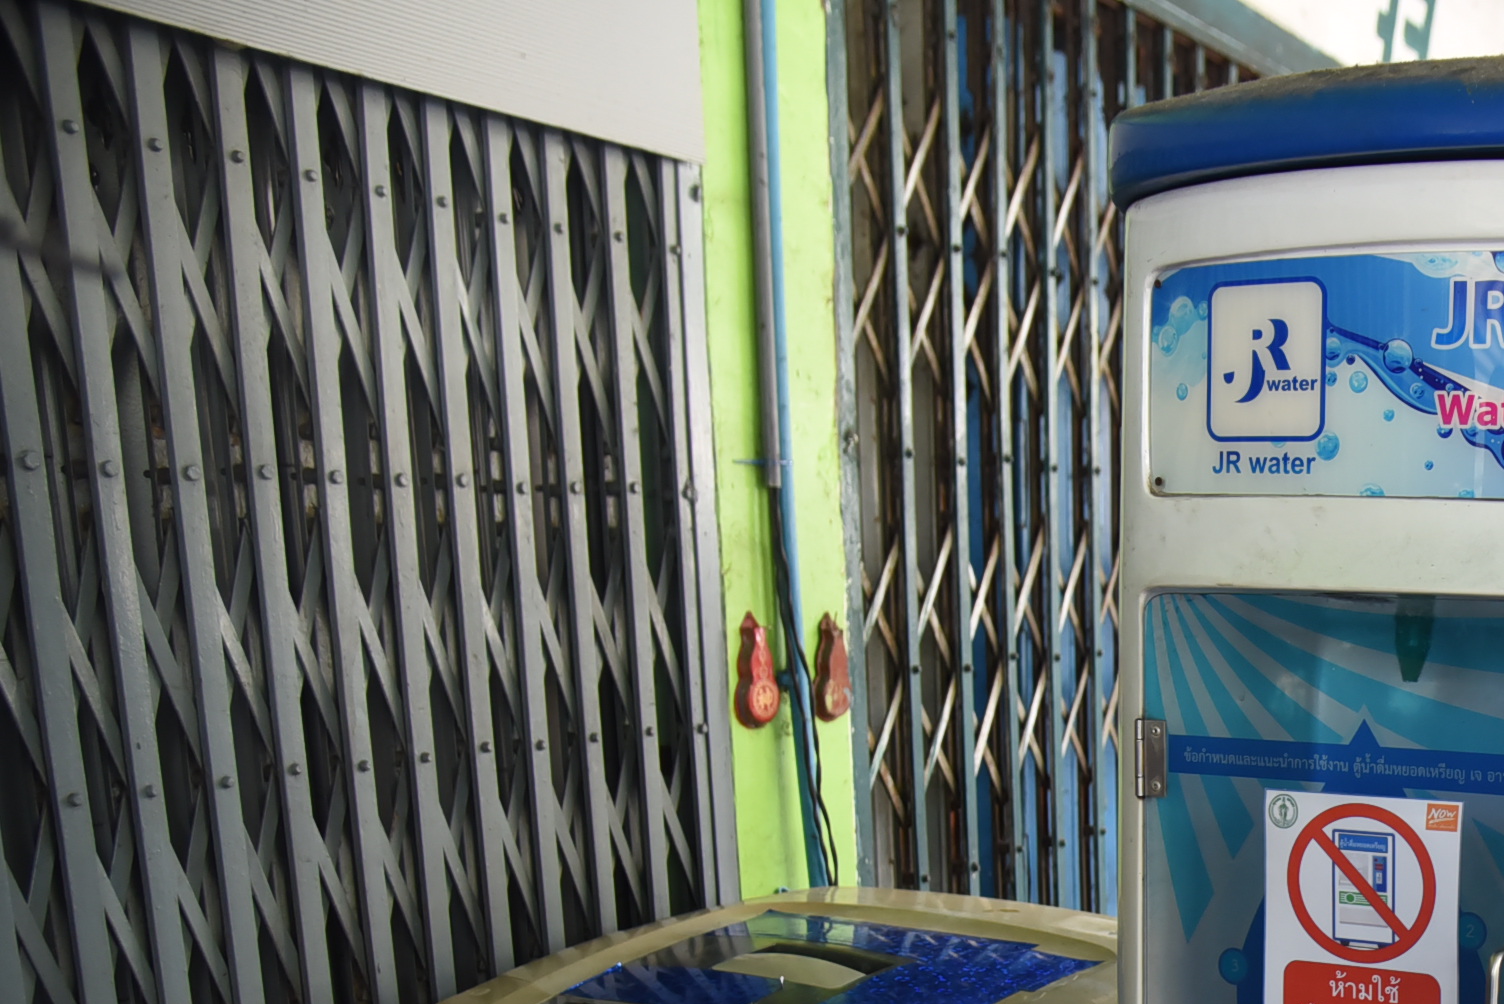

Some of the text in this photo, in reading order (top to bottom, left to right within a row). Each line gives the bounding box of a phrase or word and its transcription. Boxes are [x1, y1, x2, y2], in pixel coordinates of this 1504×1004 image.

[1266, 376, 1318, 392] water
[1212, 450, 1316, 476] JR water
[1184, 745, 1349, 773] ข้อกำหนดและแนะนำการใช้งาน
[1353, 752, 1466, 785] ตู้น้ำดื่มหยอดเหรียญ
[1470, 769, 1482, 782] เจ
[1329, 970, 1401, 1004] ห้ามใช้
